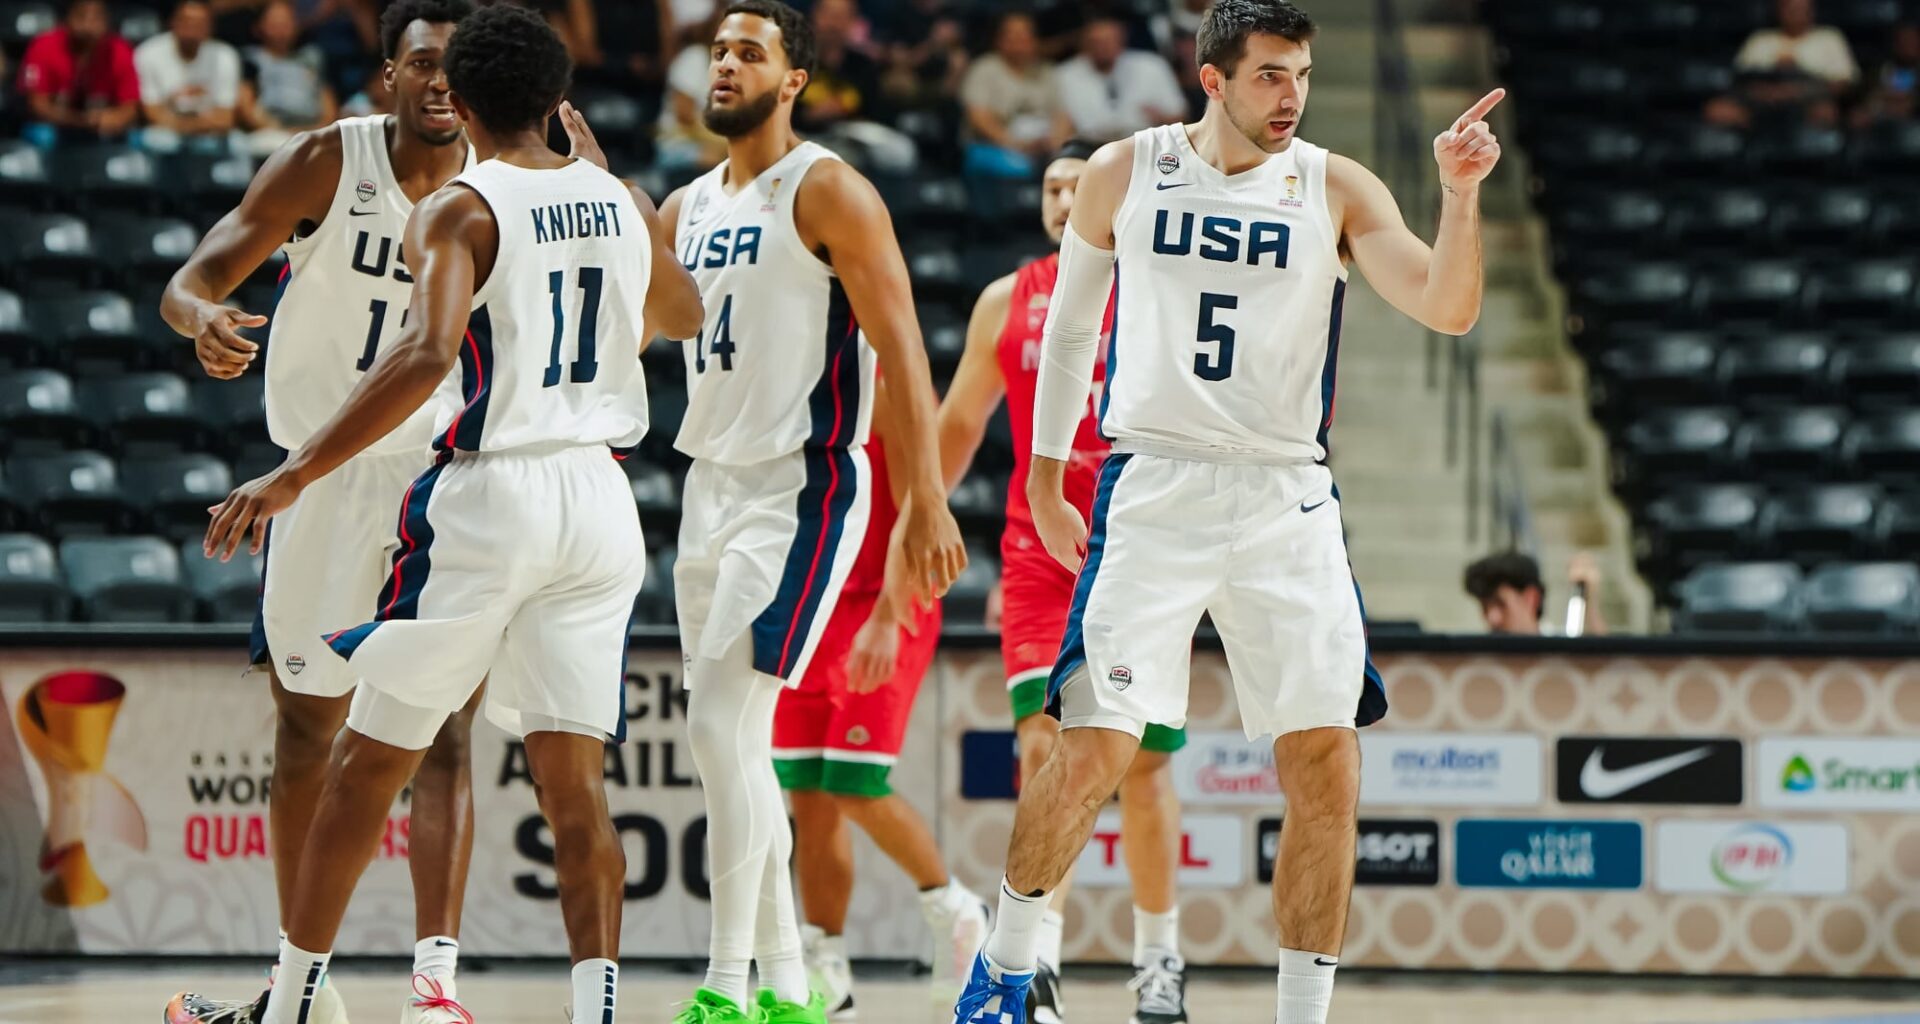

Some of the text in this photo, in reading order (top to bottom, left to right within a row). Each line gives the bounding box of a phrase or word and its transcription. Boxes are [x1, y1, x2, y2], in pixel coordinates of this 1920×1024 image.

[531, 202, 621, 244] KNIGHT
[684, 226, 762, 271] USA
[1153, 209, 1290, 269] USA
[351, 230, 414, 283] US
[542, 267, 603, 388] 11
[1193, 292, 1238, 381] 5
[1093, 833, 1209, 867] TL
